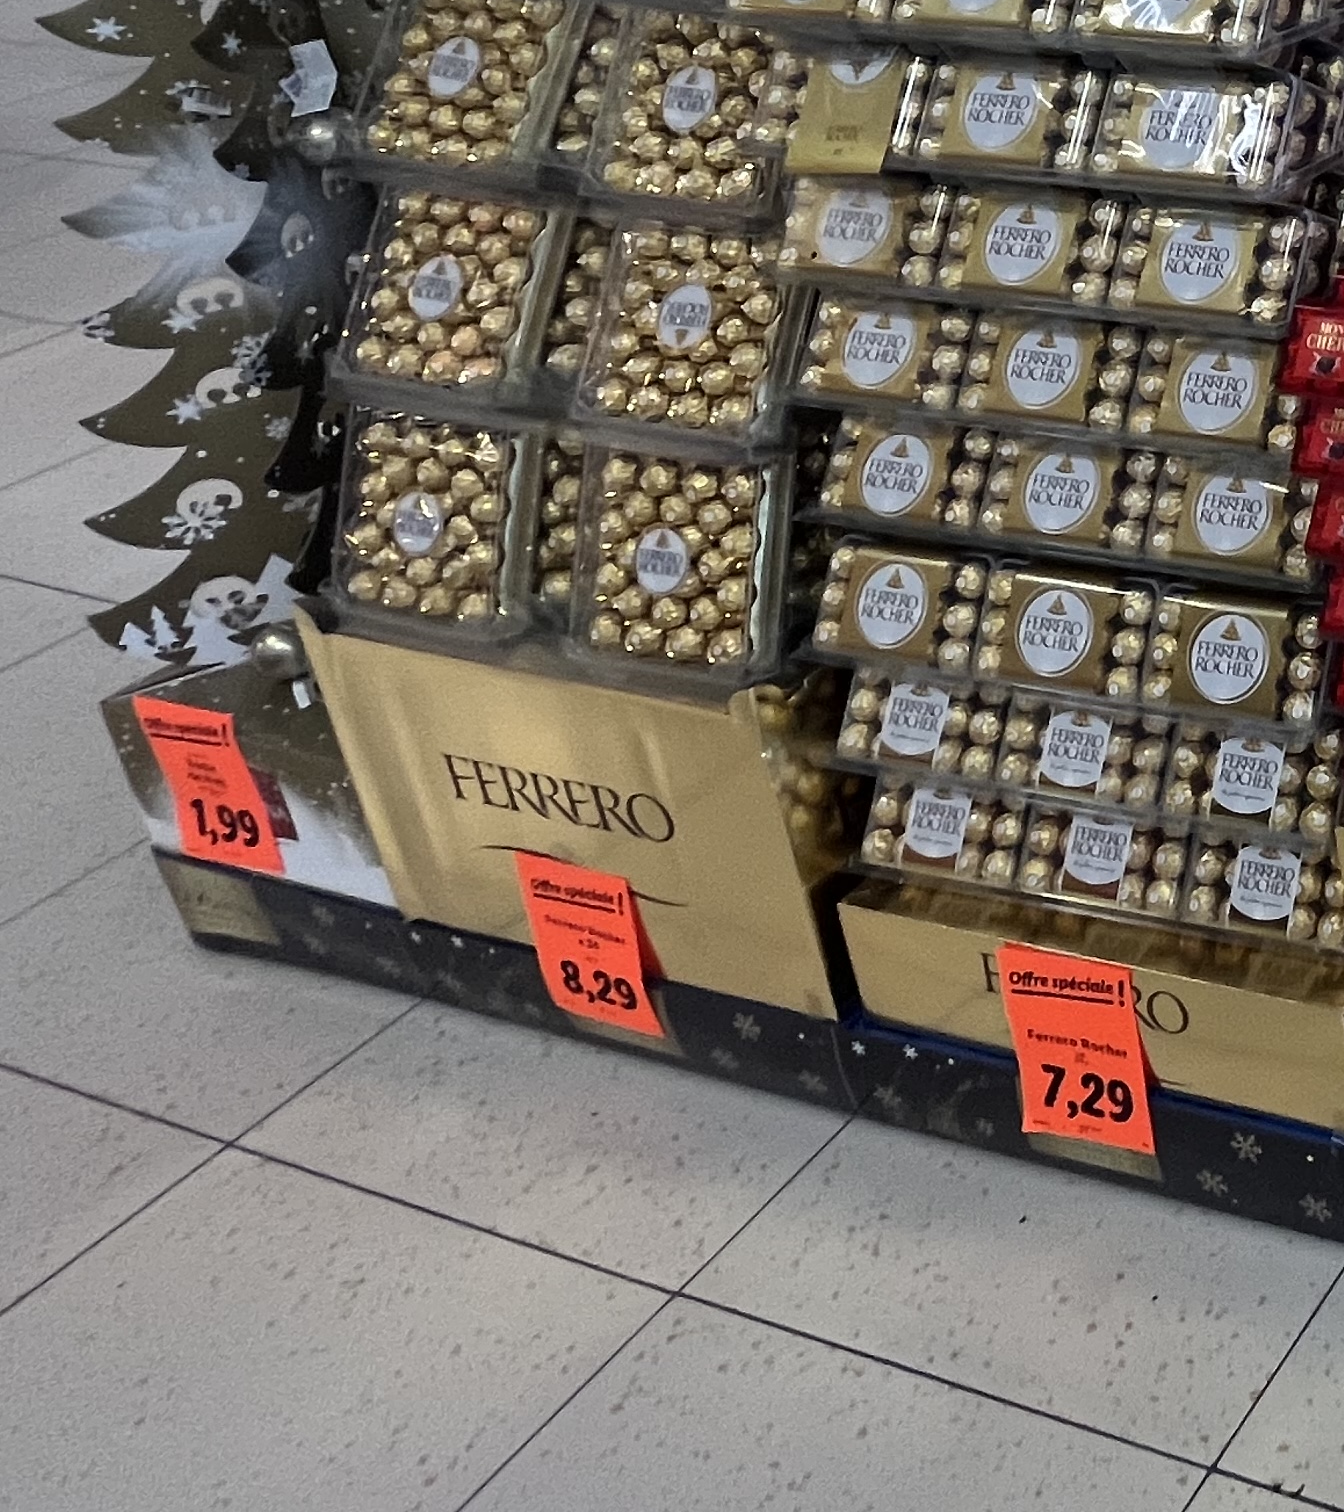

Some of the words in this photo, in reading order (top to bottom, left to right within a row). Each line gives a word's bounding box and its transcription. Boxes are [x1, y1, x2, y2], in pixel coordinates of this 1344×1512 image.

[971, 94, 1030, 111] FERRERO
[968, 105, 1025, 125] ROCHER
[828, 209, 882, 229] FERRERO
[822, 221, 877, 241] ROCHER
[994, 227, 1052, 245] FERRERO
[988, 239, 1045, 260] ROCHER
[1168, 244, 1230, 263] FERRERO
[1165, 257, 1224, 279] ROCHER
[852, 331, 905, 350] FERRERO
[847, 343, 900, 365] ROCHER
[1015, 349, 1071, 369] FERRERO
[1011, 362, 1066, 385] ROCHER
[1186, 373, 1247, 392] FERRERO
[1183, 387, 1242, 410] ROCHER
[869, 458, 923, 479] FERRERO
[865, 471, 917, 494] ROCHER
[1033, 473, 1090, 494] FERRERO
[1028, 487, 1084, 511] ROCHER
[1203, 496, 1263, 518] FERRERO
[1200, 509, 1258, 532] ROCHER
[863, 589, 919, 611] FERRERO
[861, 602, 914, 625] ROCHER
[1027, 615, 1083, 637] FERRERO
[1024, 628, 1079, 653] ROCHER
[1197, 641, 1259, 663] FERRERO
[1195, 654, 1254, 679] ROCHER
[1052, 727, 1104, 748] FERRERO
[1048, 742, 1099, 763] ROCHER
[1223, 753, 1278, 774] FERRERO
[1219, 768, 1273, 790] ROCHER
[443, 753, 675, 844] FERRERO
[190, 798, 260, 848] 1,99
[1242, 860, 1295, 882] FERRERO
[1238, 874, 1291, 898] ROCHER
[560, 959, 637, 1010] 8,29
[1008, 970, 1049, 988] Offre
[1051, 976, 1114, 995] spéciale
[1117, 979, 1126, 1008] !
[1040, 1063, 1135, 1124] 7,29
